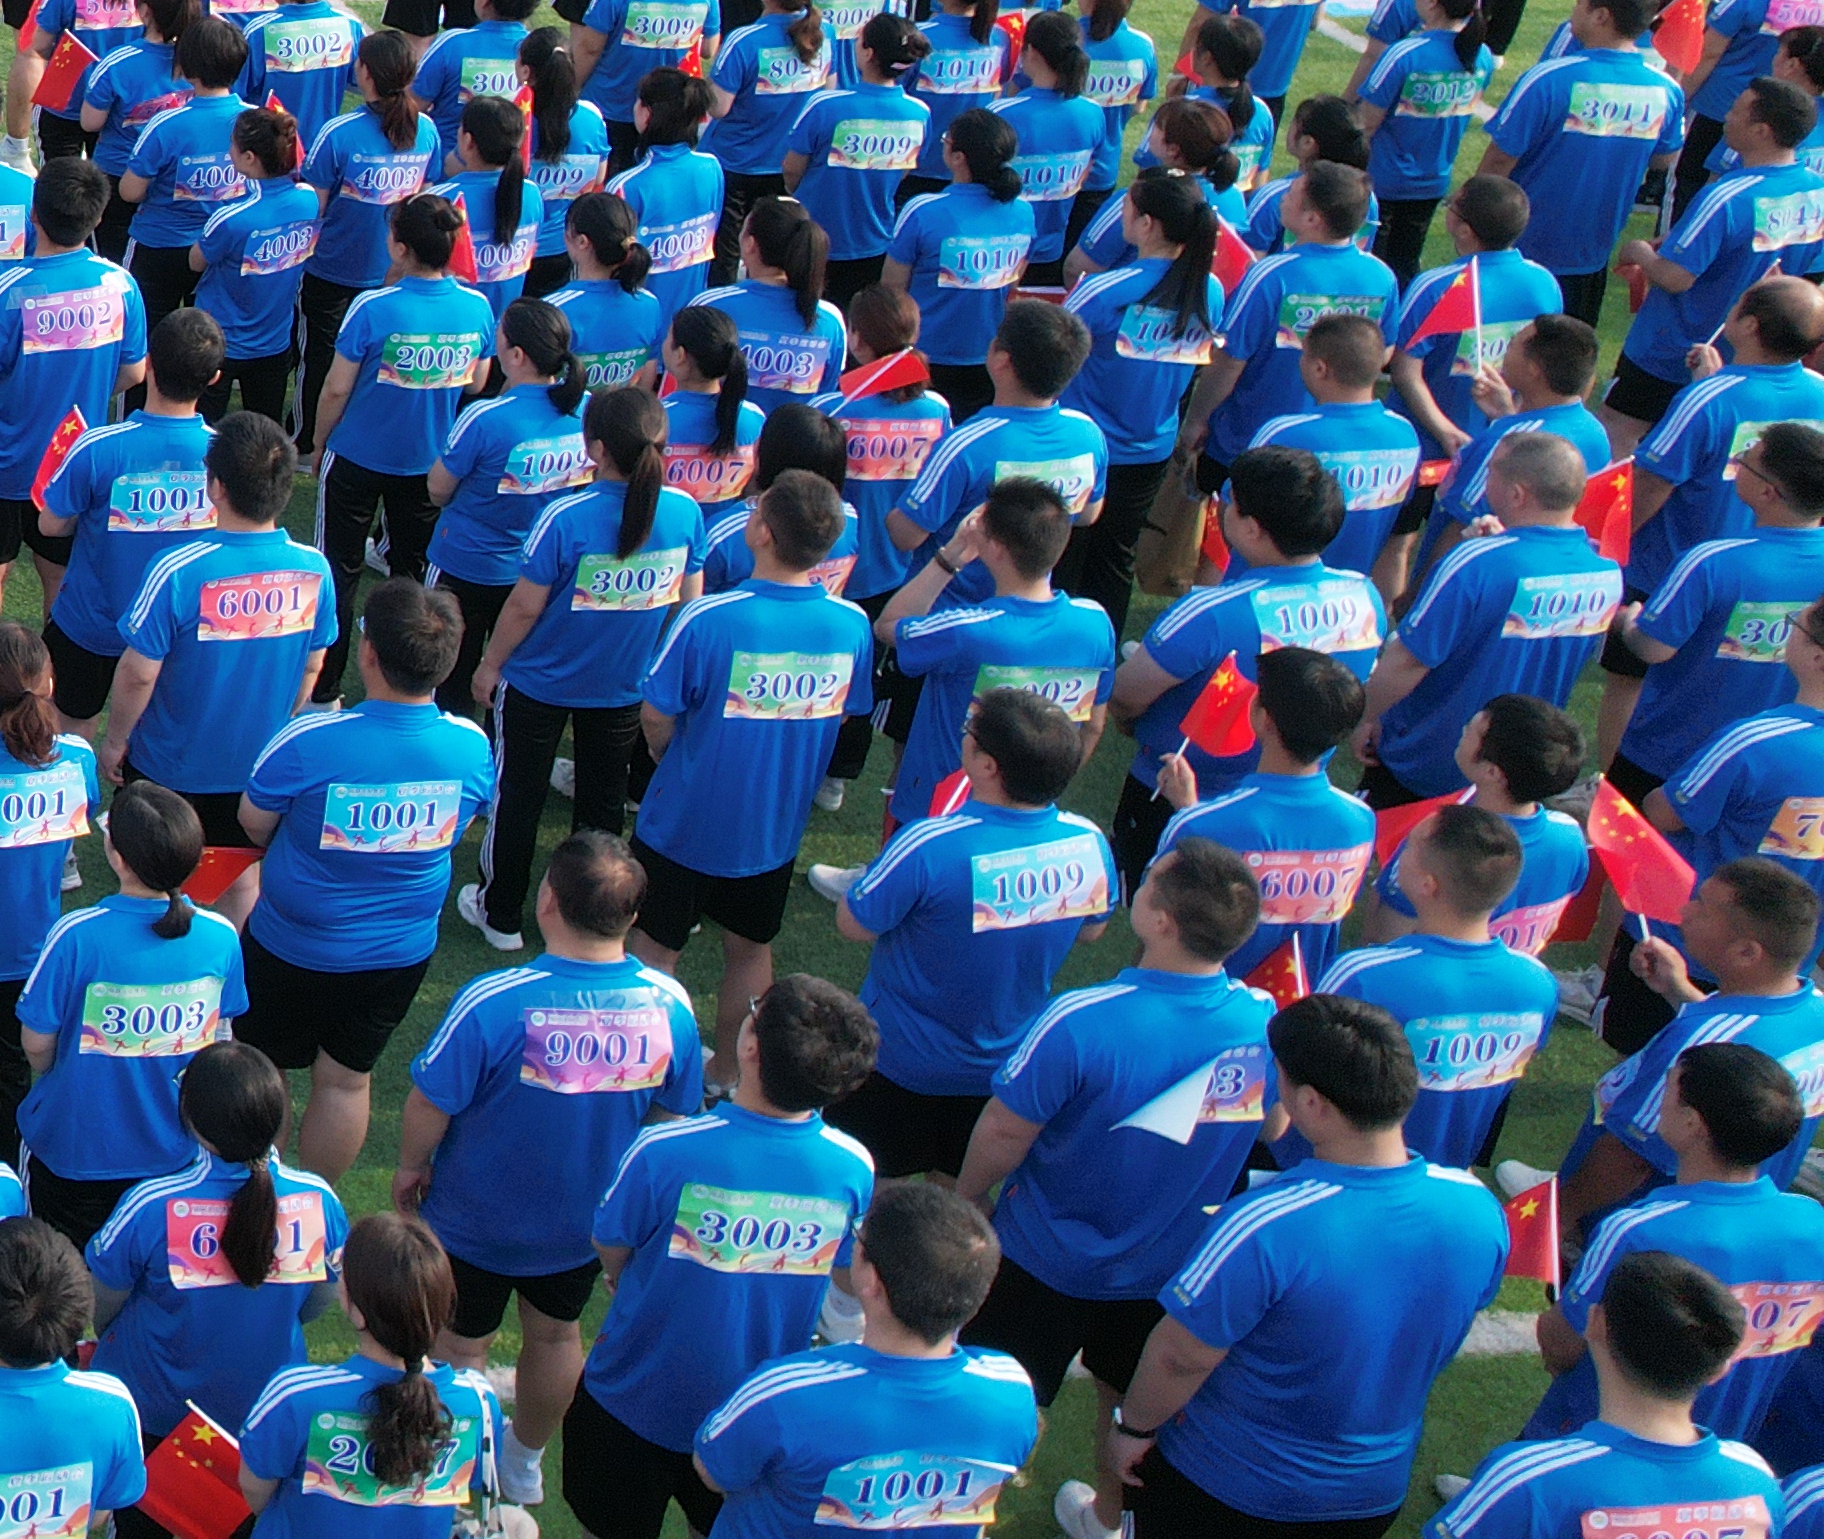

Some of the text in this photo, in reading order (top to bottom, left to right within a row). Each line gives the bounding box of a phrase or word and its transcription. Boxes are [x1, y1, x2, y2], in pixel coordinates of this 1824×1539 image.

[636, 12, 696, 36] 3009
[1777, 3, 1821, 27] 500
[276, 32, 343, 59] 3002
[933, 57, 993, 78] 1010
[474, 73, 518, 94] 300
[1086, 72, 1130, 95] 009
[1582, 97, 1652, 120] 3011
[844, 132, 911, 155] 3009
[186, 162, 243, 187] 400
[355, 166, 421, 189] 4003
[530, 164, 583, 185] 009
[1019, 160, 1083, 184] 1010
[255, 230, 315, 261] 4003
[474, 242, 528, 266] 003
[957, 249, 1019, 269] 1010
[36, 305, 113, 334] 9002
[394, 347, 472, 372] 2003
[586, 361, 633, 386] 003
[848, 435, 929, 460] 6007
[666, 463, 742, 486] 6007
[1346, 463, 1402, 491] 010
[129, 488, 207, 514] 1001
[594, 568, 675, 595] 3002
[219, 587, 301, 617] 6001
[1529, 589, 1605, 616] 1010
[1279, 599, 1357, 635] 1009
[747, 673, 838, 700] 3002
[346, 800, 438, 830] 1001
[993, 863, 1083, 903] 1009
[1258, 867, 1358, 900] 6007
[102, 1003, 204, 1034] 3003
[544, 1033, 651, 1067] 9001
[1427, 1032, 1521, 1065] 1009
[696, 1212, 822, 1253] 3003
[857, 1470, 974, 1505] 1001
